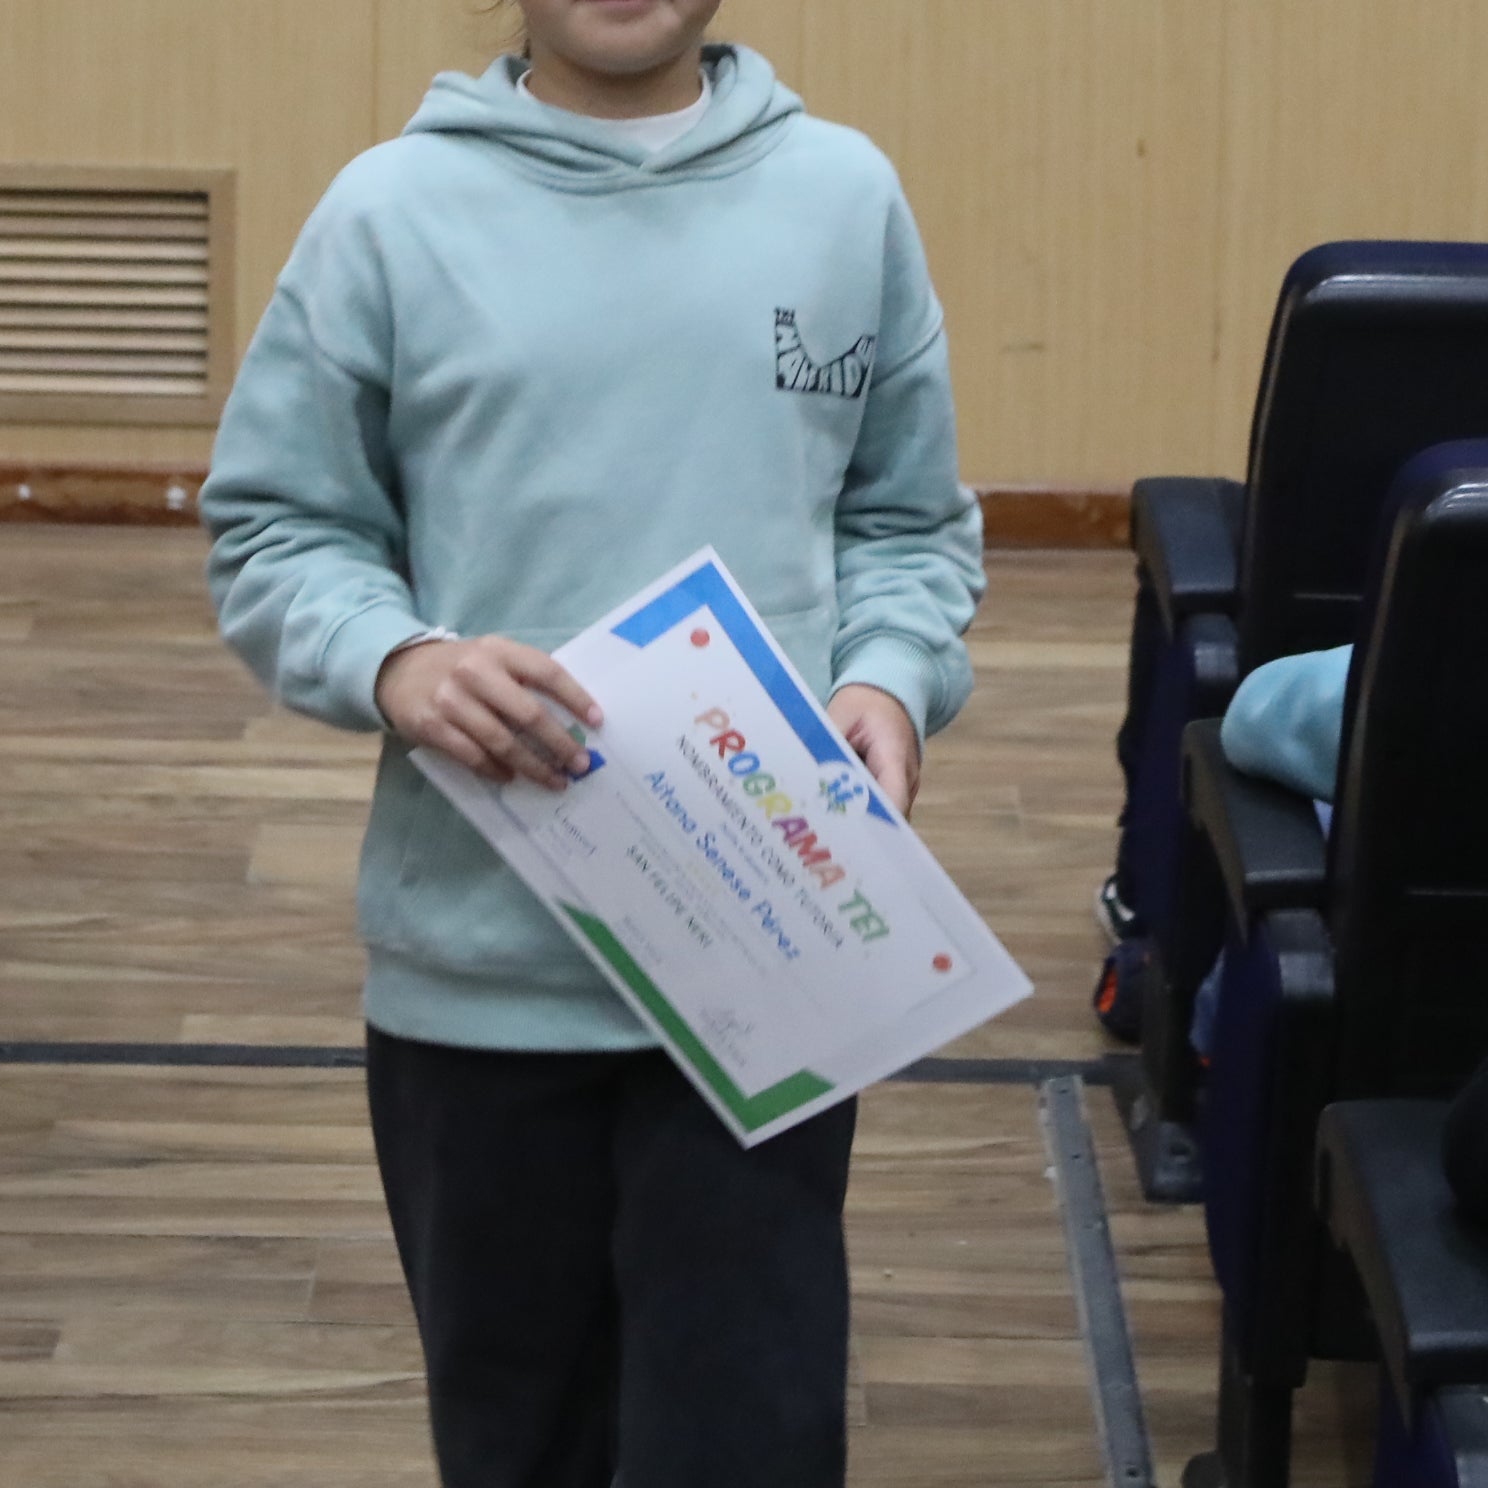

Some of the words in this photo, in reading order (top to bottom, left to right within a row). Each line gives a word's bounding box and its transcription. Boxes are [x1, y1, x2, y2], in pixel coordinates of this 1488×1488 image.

[644, 770, 697, 834] Aitana
[677, 734, 763, 846] NOMBRAMIENTO
[761, 845, 796, 886] COMO
[693, 705, 846, 891] PROGRAMA
[837, 888, 890, 942] TEI
[627, 845, 649, 872] SAN
